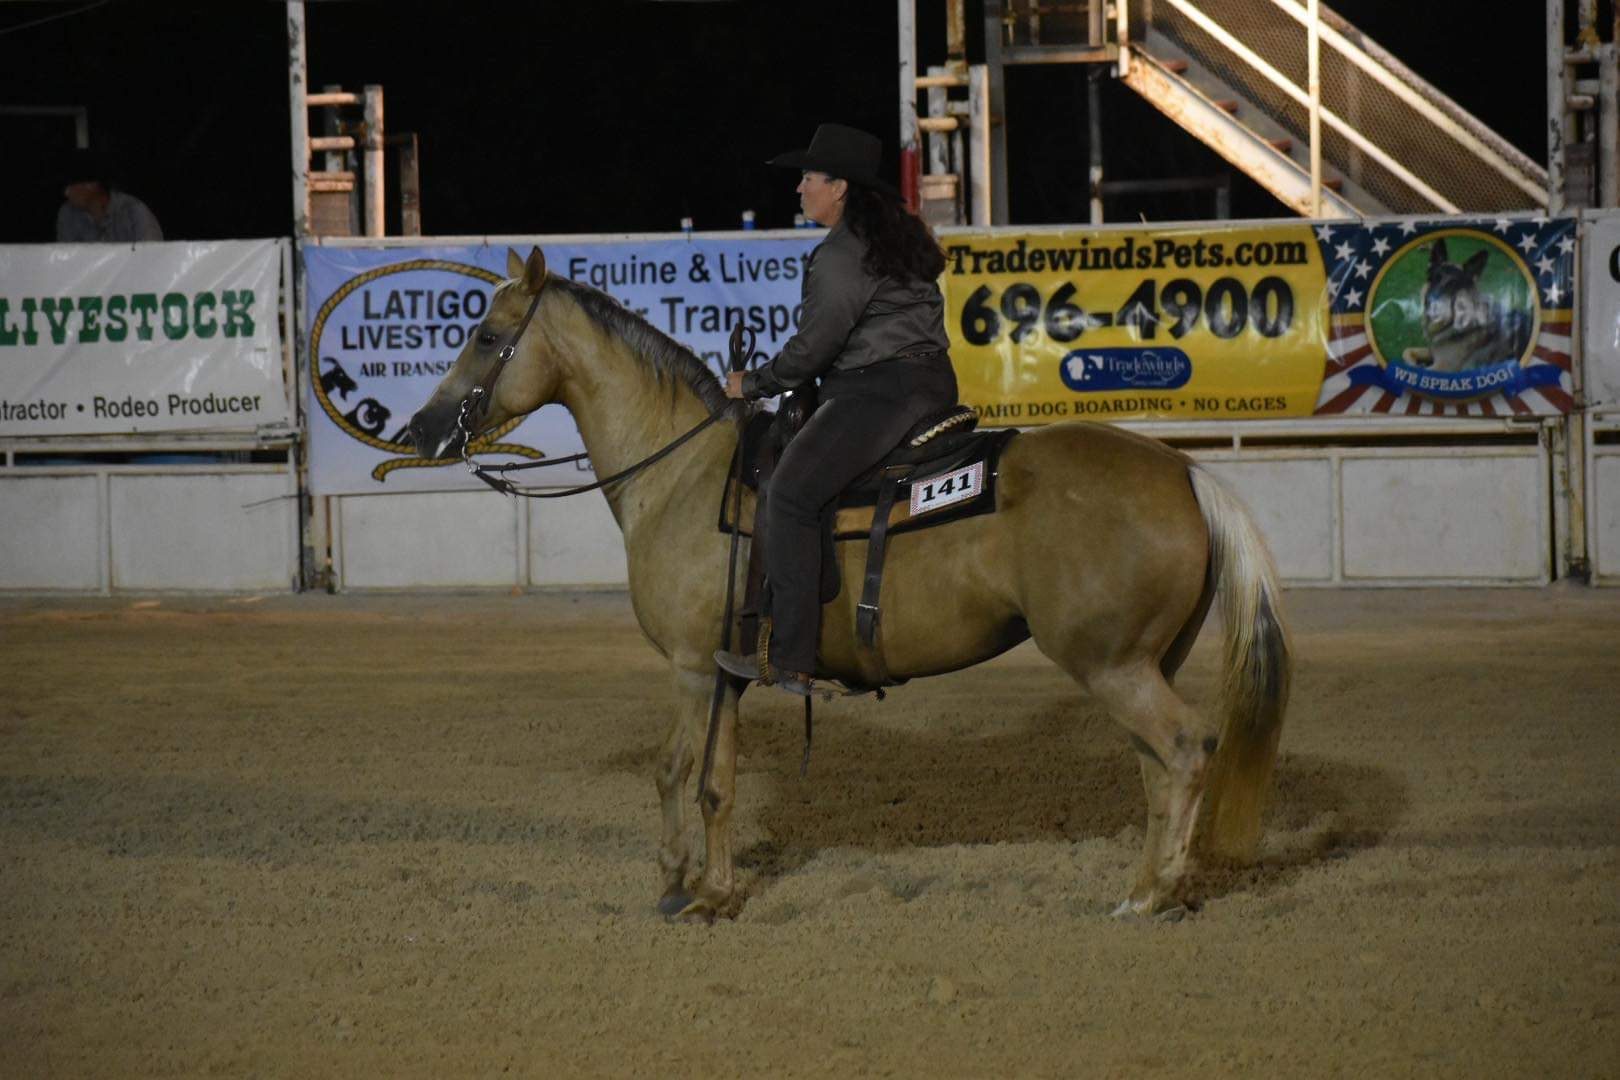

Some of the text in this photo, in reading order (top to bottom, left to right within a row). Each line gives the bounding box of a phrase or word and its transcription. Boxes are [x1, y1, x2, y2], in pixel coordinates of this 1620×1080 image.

[949, 238, 1308, 275] TradewindsPets.com
[569, 255, 677, 292] Equine
[688, 253, 711, 282] &
[0, 289, 255, 346] LIVESTOCK
[363, 290, 487, 320] LATIGO
[960, 276, 1294, 346] 696-4900
[359, 362, 386, 377] AIR
[1420, 376, 1473, 391] SPEAK
[0, 393, 261, 421] tractor Rodeo Producer
[1028, 401, 1068, 416] DOG
[1074, 398, 1172, 414] BOARDING
[1193, 398, 1220, 412] NO
[1224, 396, 1287, 412] CAGES
[922, 472, 972, 503] 141
